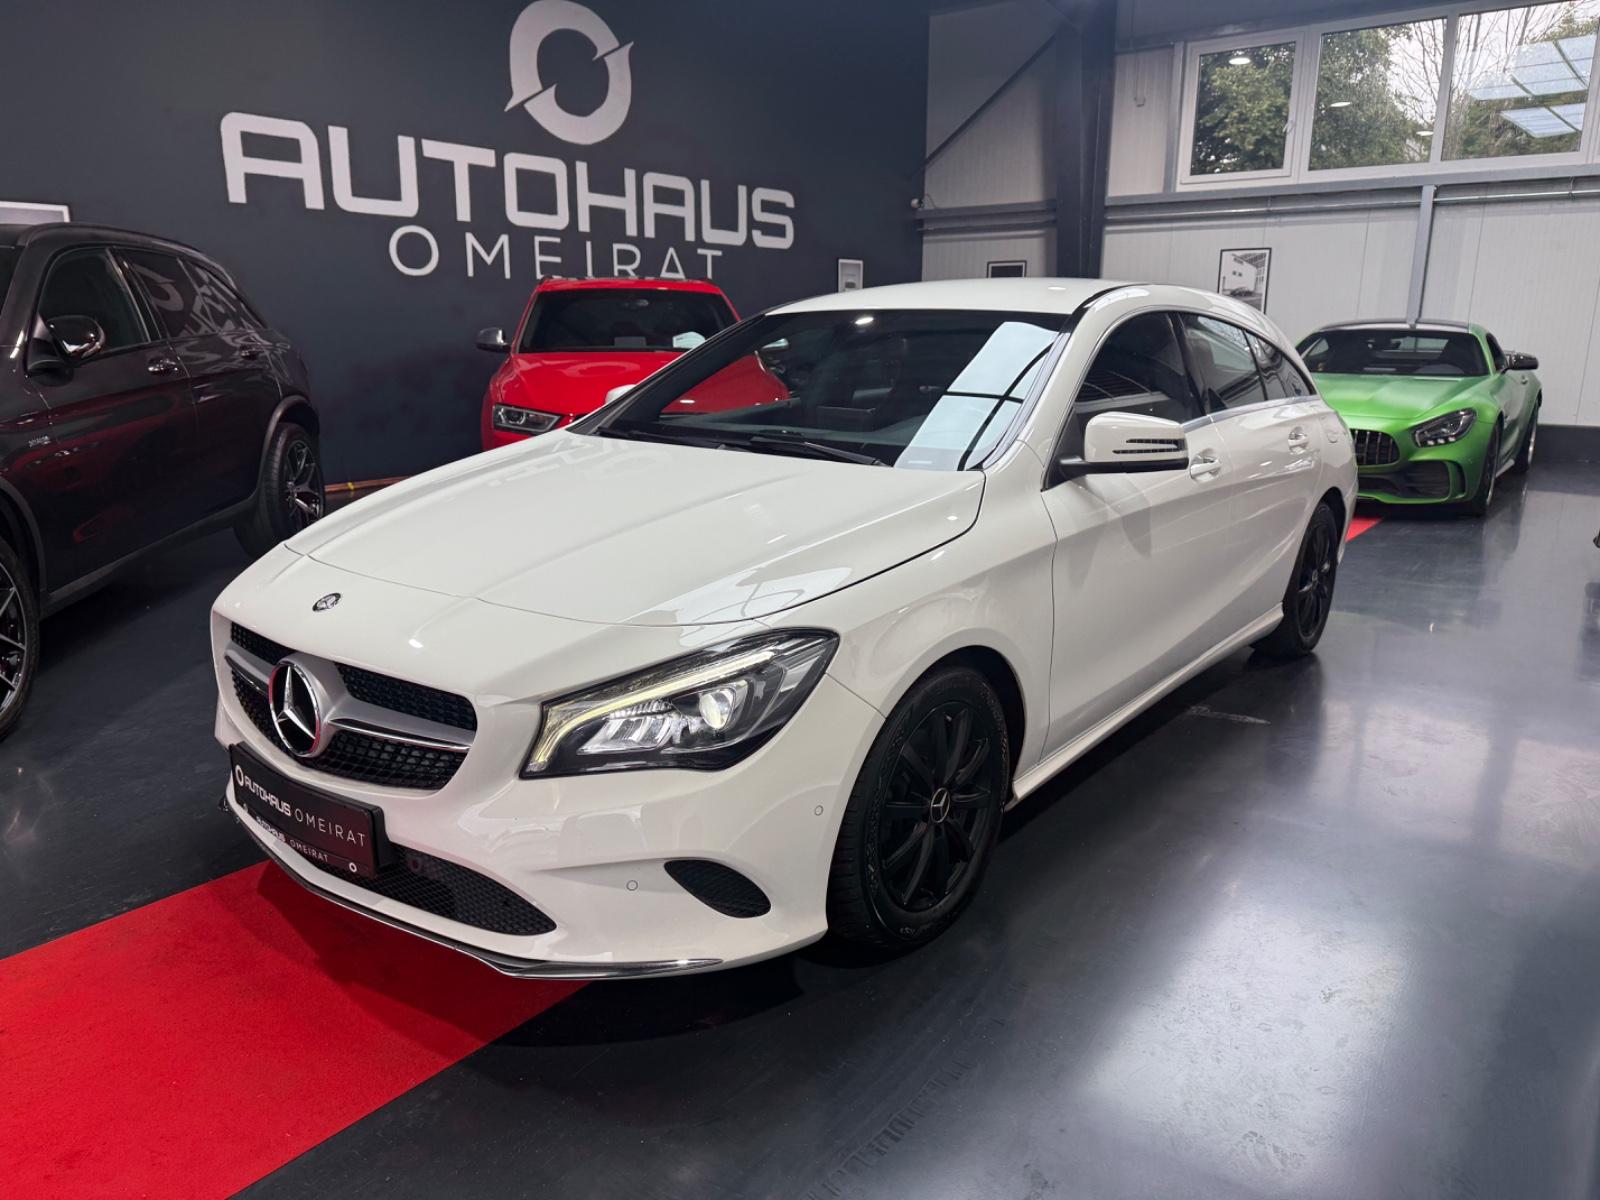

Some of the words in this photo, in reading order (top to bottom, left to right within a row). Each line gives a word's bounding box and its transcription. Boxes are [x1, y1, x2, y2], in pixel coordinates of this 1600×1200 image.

[220, 111, 795, 250] AUTOHAUS
[388, 225, 723, 279] OMEIRAT
[244, 776, 292, 817] AUTOHAUS
[294, 808, 366, 848] OMEIRAT
[289, 839, 329, 863] OMEIRAT
